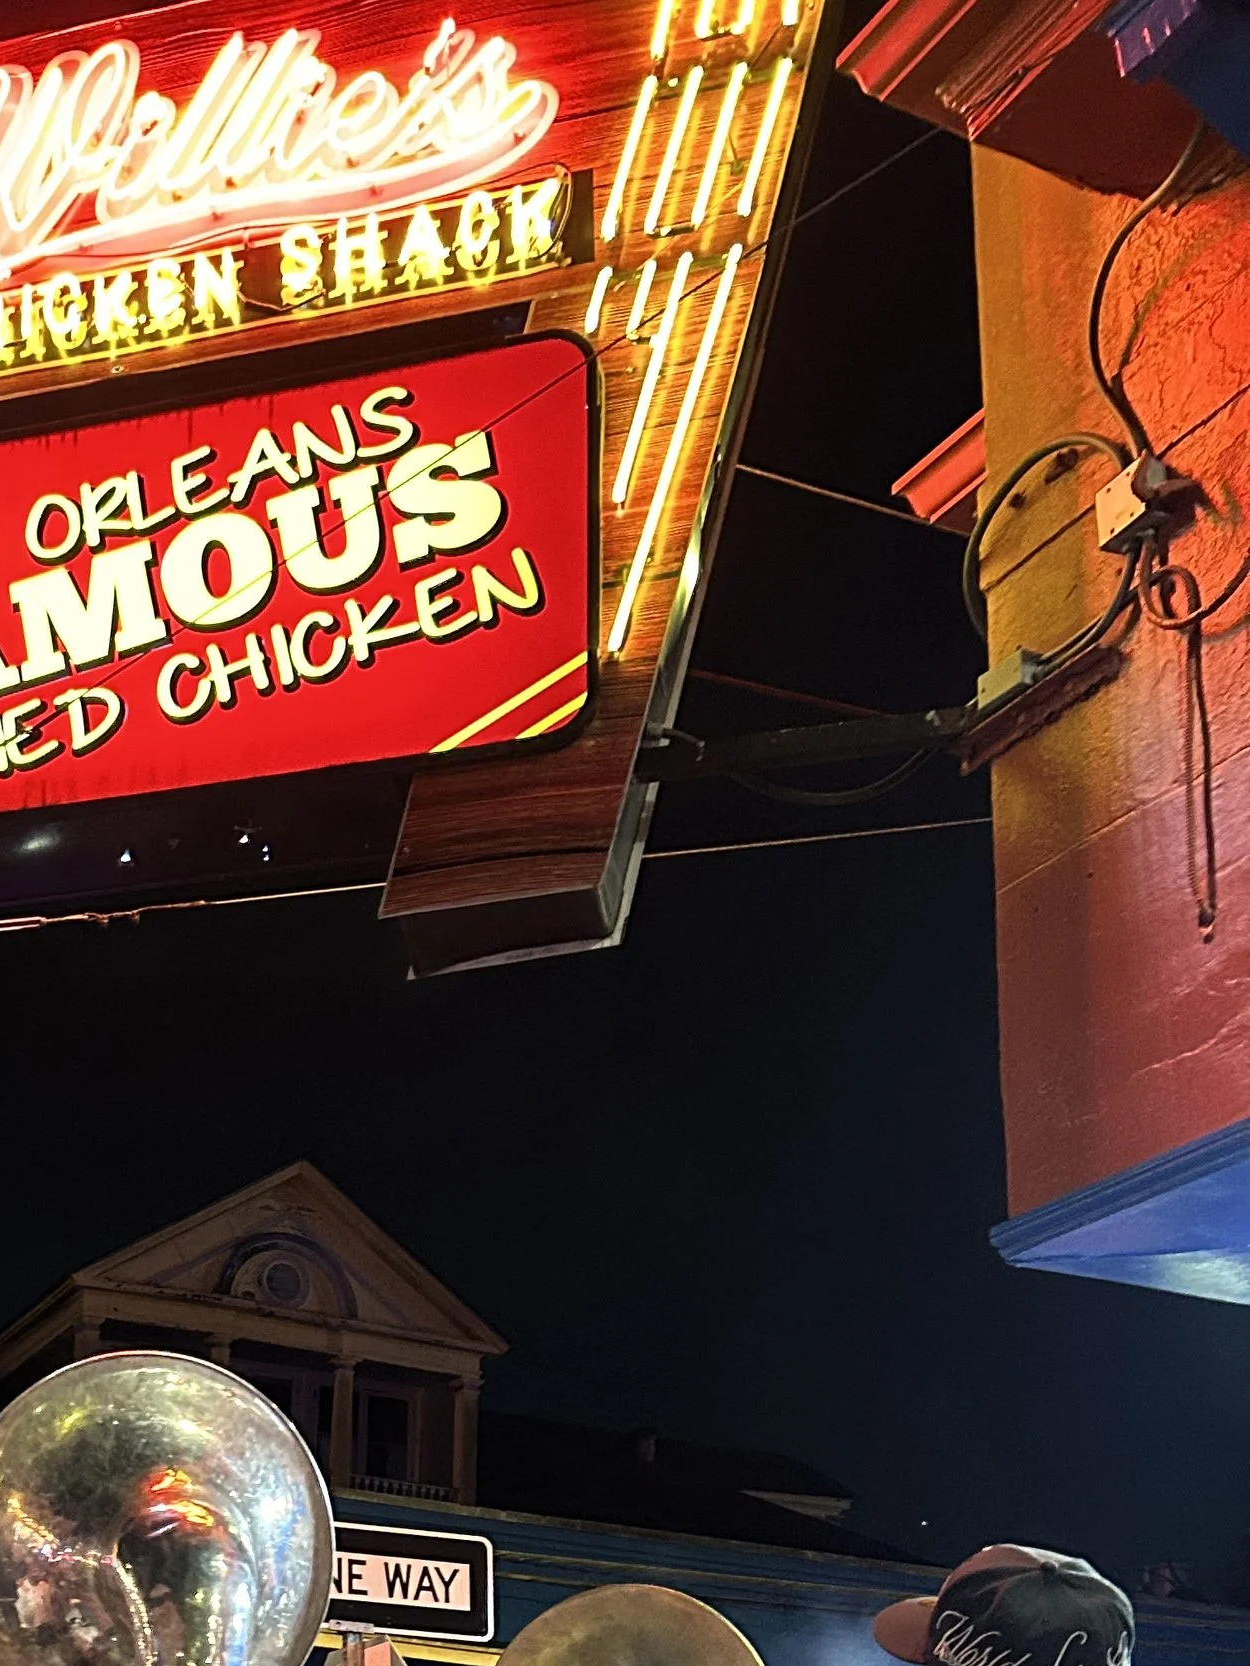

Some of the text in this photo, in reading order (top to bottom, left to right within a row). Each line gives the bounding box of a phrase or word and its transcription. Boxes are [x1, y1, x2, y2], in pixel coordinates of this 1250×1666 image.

[280, 177, 562, 302] SHACK
[26, 387, 416, 559] ORLEANS
[157, 548, 542, 720] CHICKEN
[384, 1562, 459, 1603] WAY
